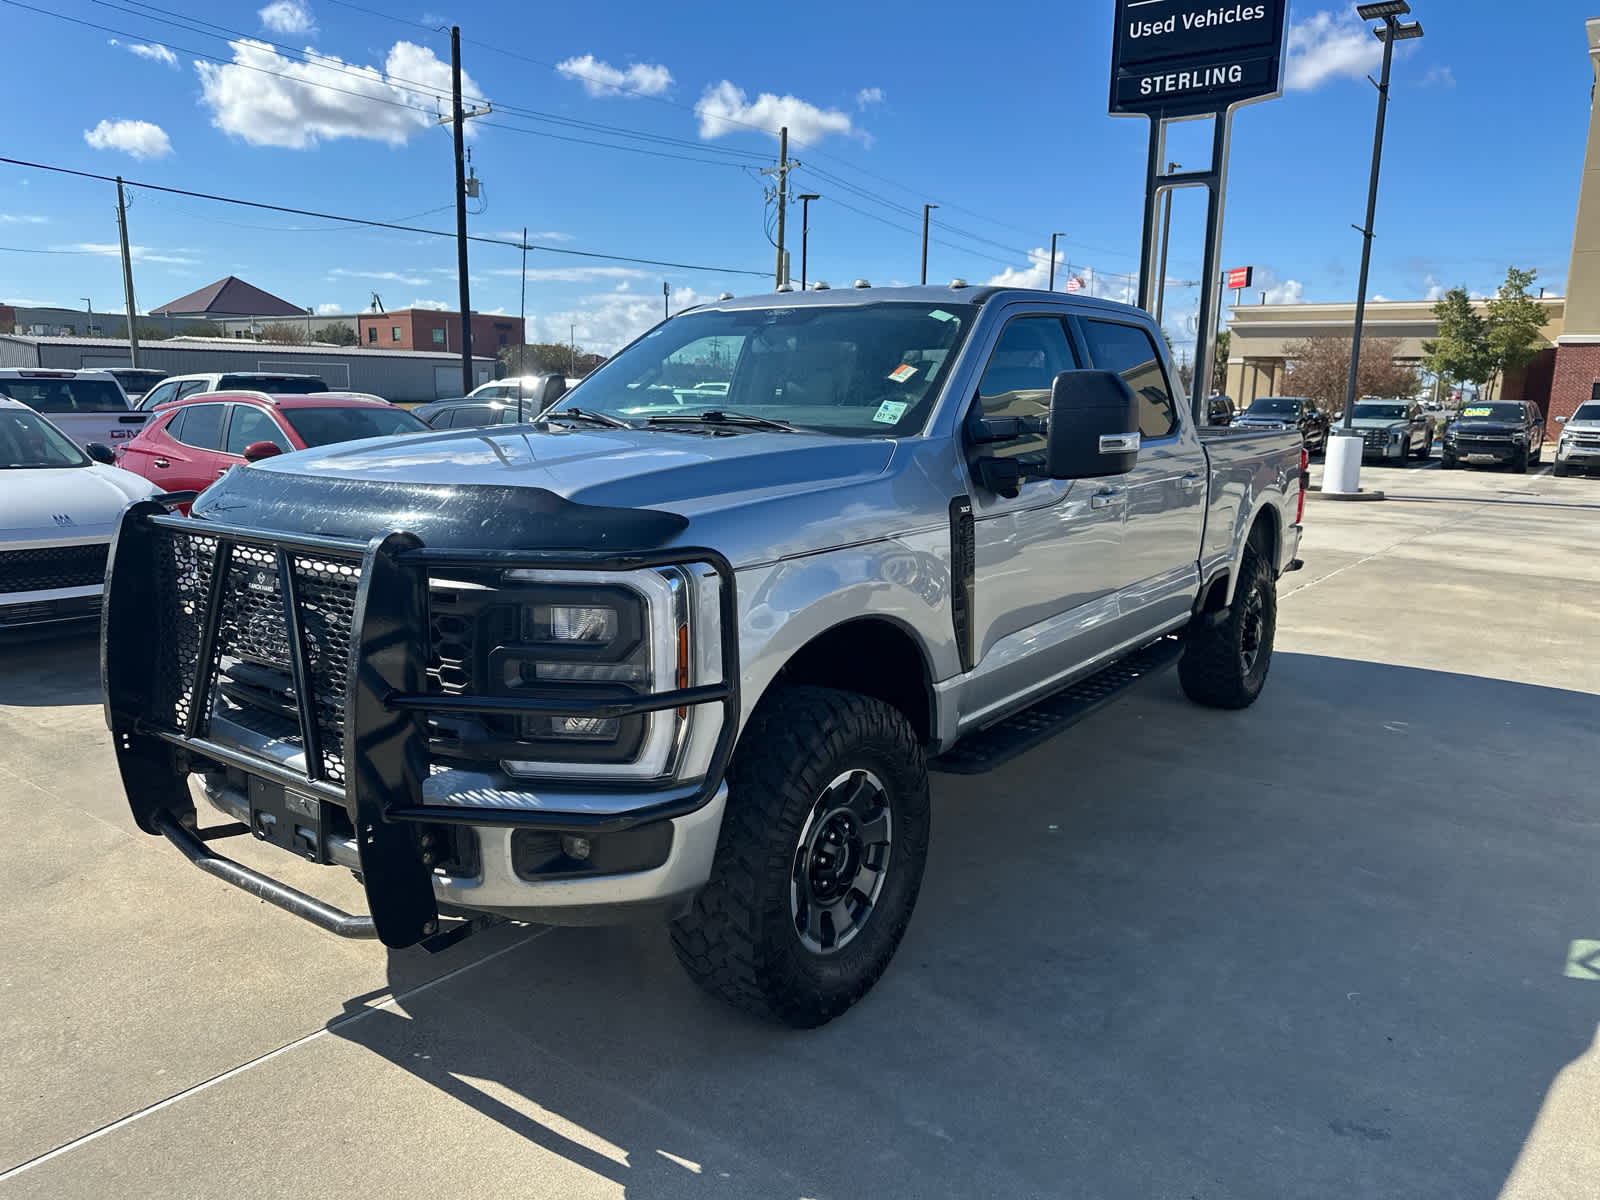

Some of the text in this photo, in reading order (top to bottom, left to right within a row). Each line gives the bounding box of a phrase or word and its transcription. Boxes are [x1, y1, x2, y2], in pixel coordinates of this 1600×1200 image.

[1129, 4, 1265, 38] Used Vehicles
[1140, 65, 1242, 95] STERLING
[110, 430, 143, 439] GM
